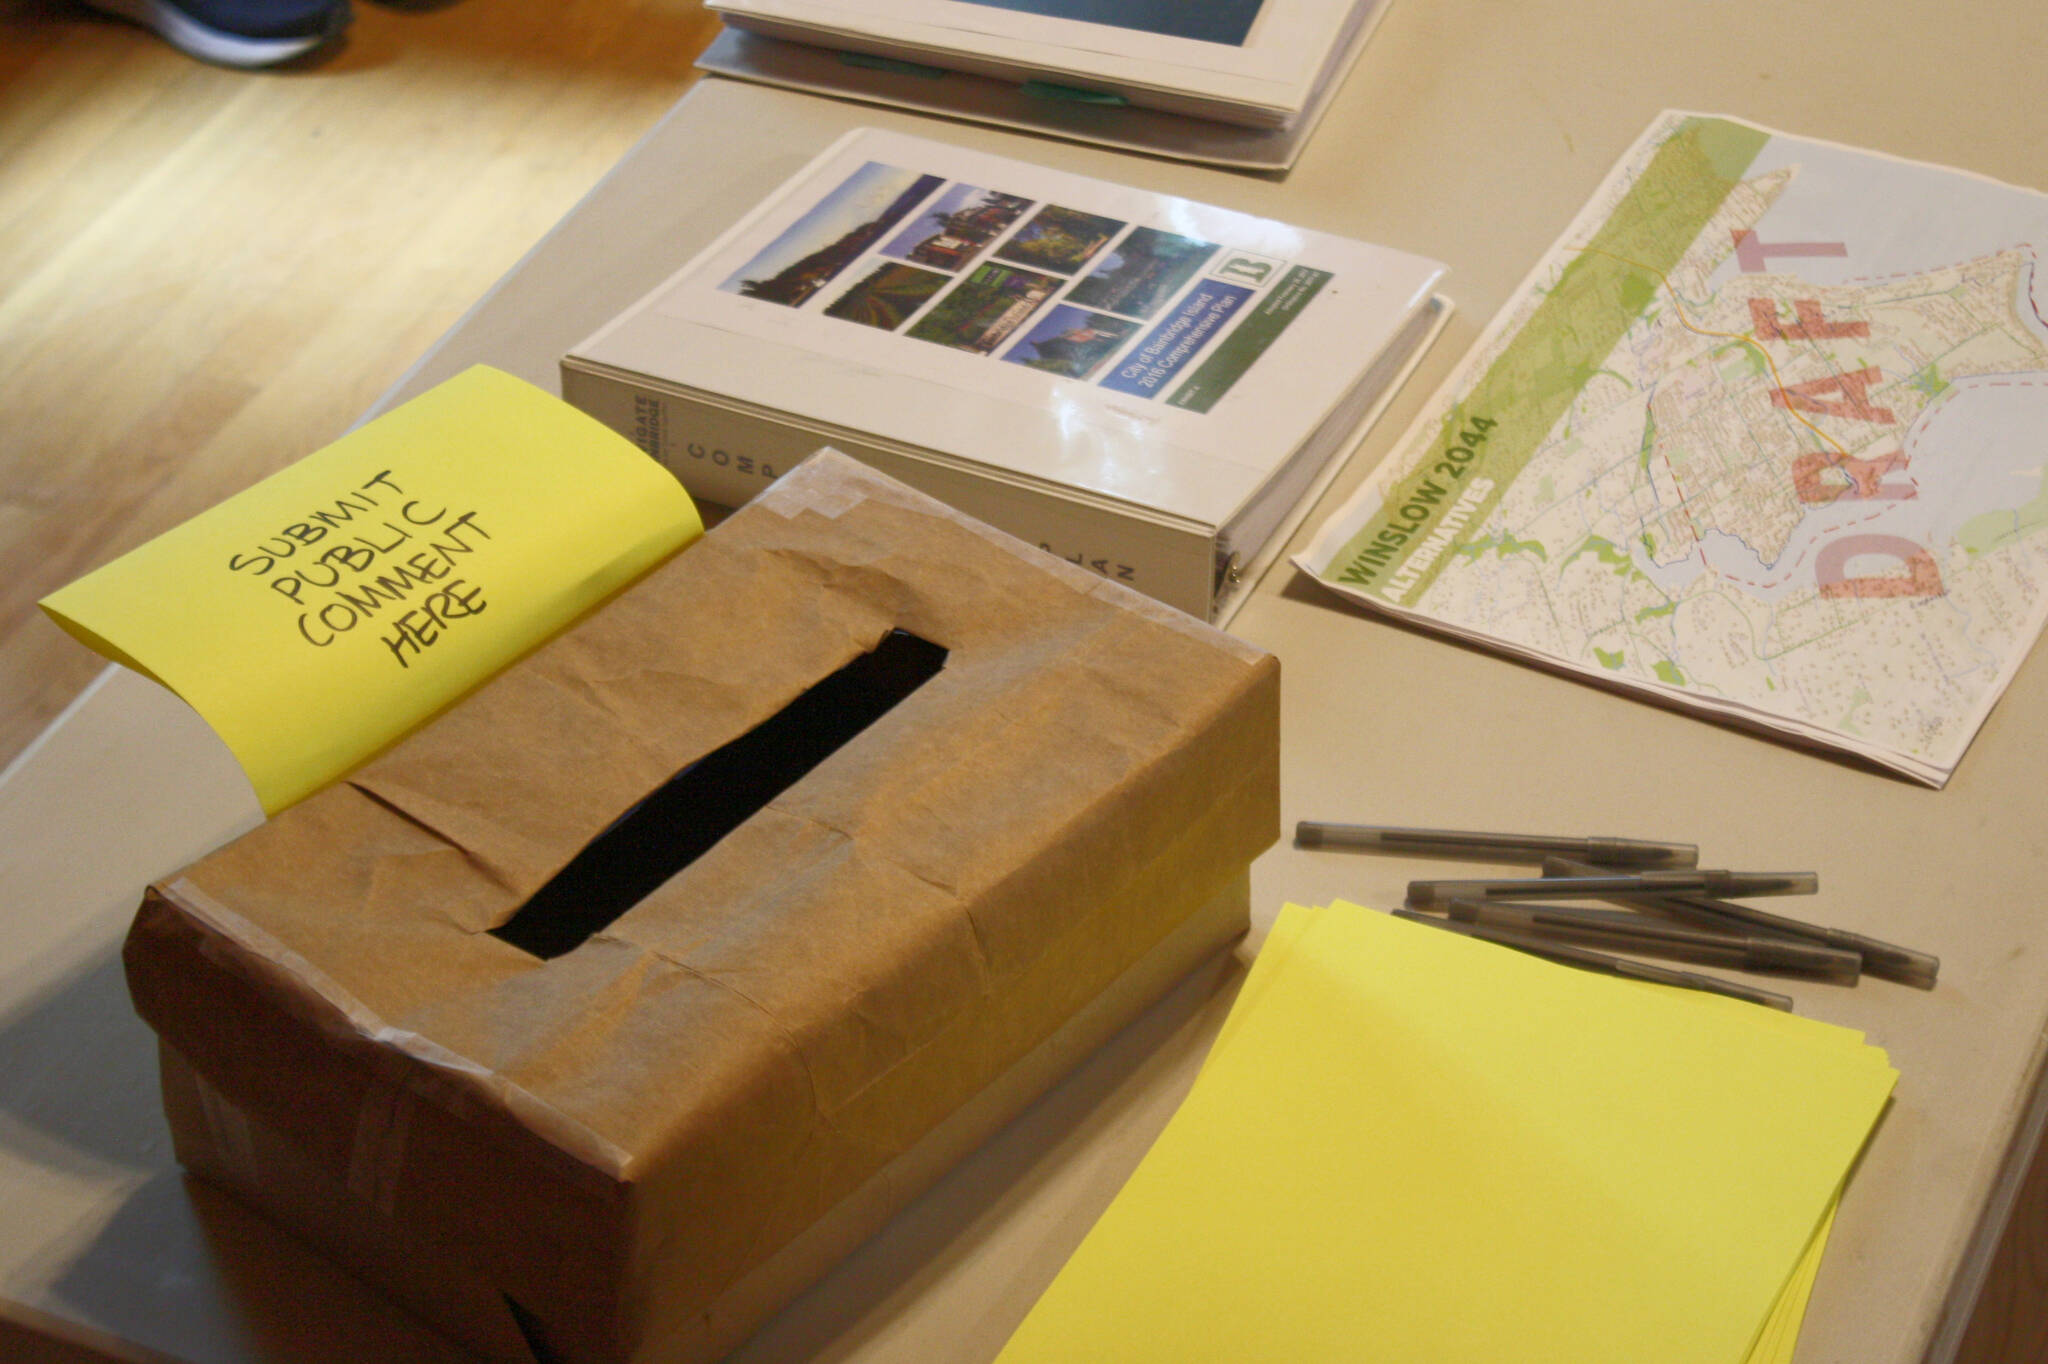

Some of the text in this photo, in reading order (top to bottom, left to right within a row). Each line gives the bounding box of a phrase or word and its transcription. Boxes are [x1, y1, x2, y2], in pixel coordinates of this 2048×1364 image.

[1137, 366, 1167, 389] 2016
[1156, 311, 1222, 369] Comprehensive
[1210, 294, 1239, 315] Plan
[1143, 315, 1193, 355] Bainbridge
[1181, 292, 1214, 318] Island
[1120, 361, 1149, 379] City
[1139, 352, 1155, 365] of
[1729, 229, 1945, 600] DRAFT
[228, 469, 403, 576] SUBMIT
[1337, 415, 1499, 586] WINSLOW 2044
[1380, 476, 1496, 604] ALTERNATIVES
[270, 500, 447, 606] PUBLIC
[297, 511, 492, 647] COMMENT
[380, 579, 488, 669] HERE
